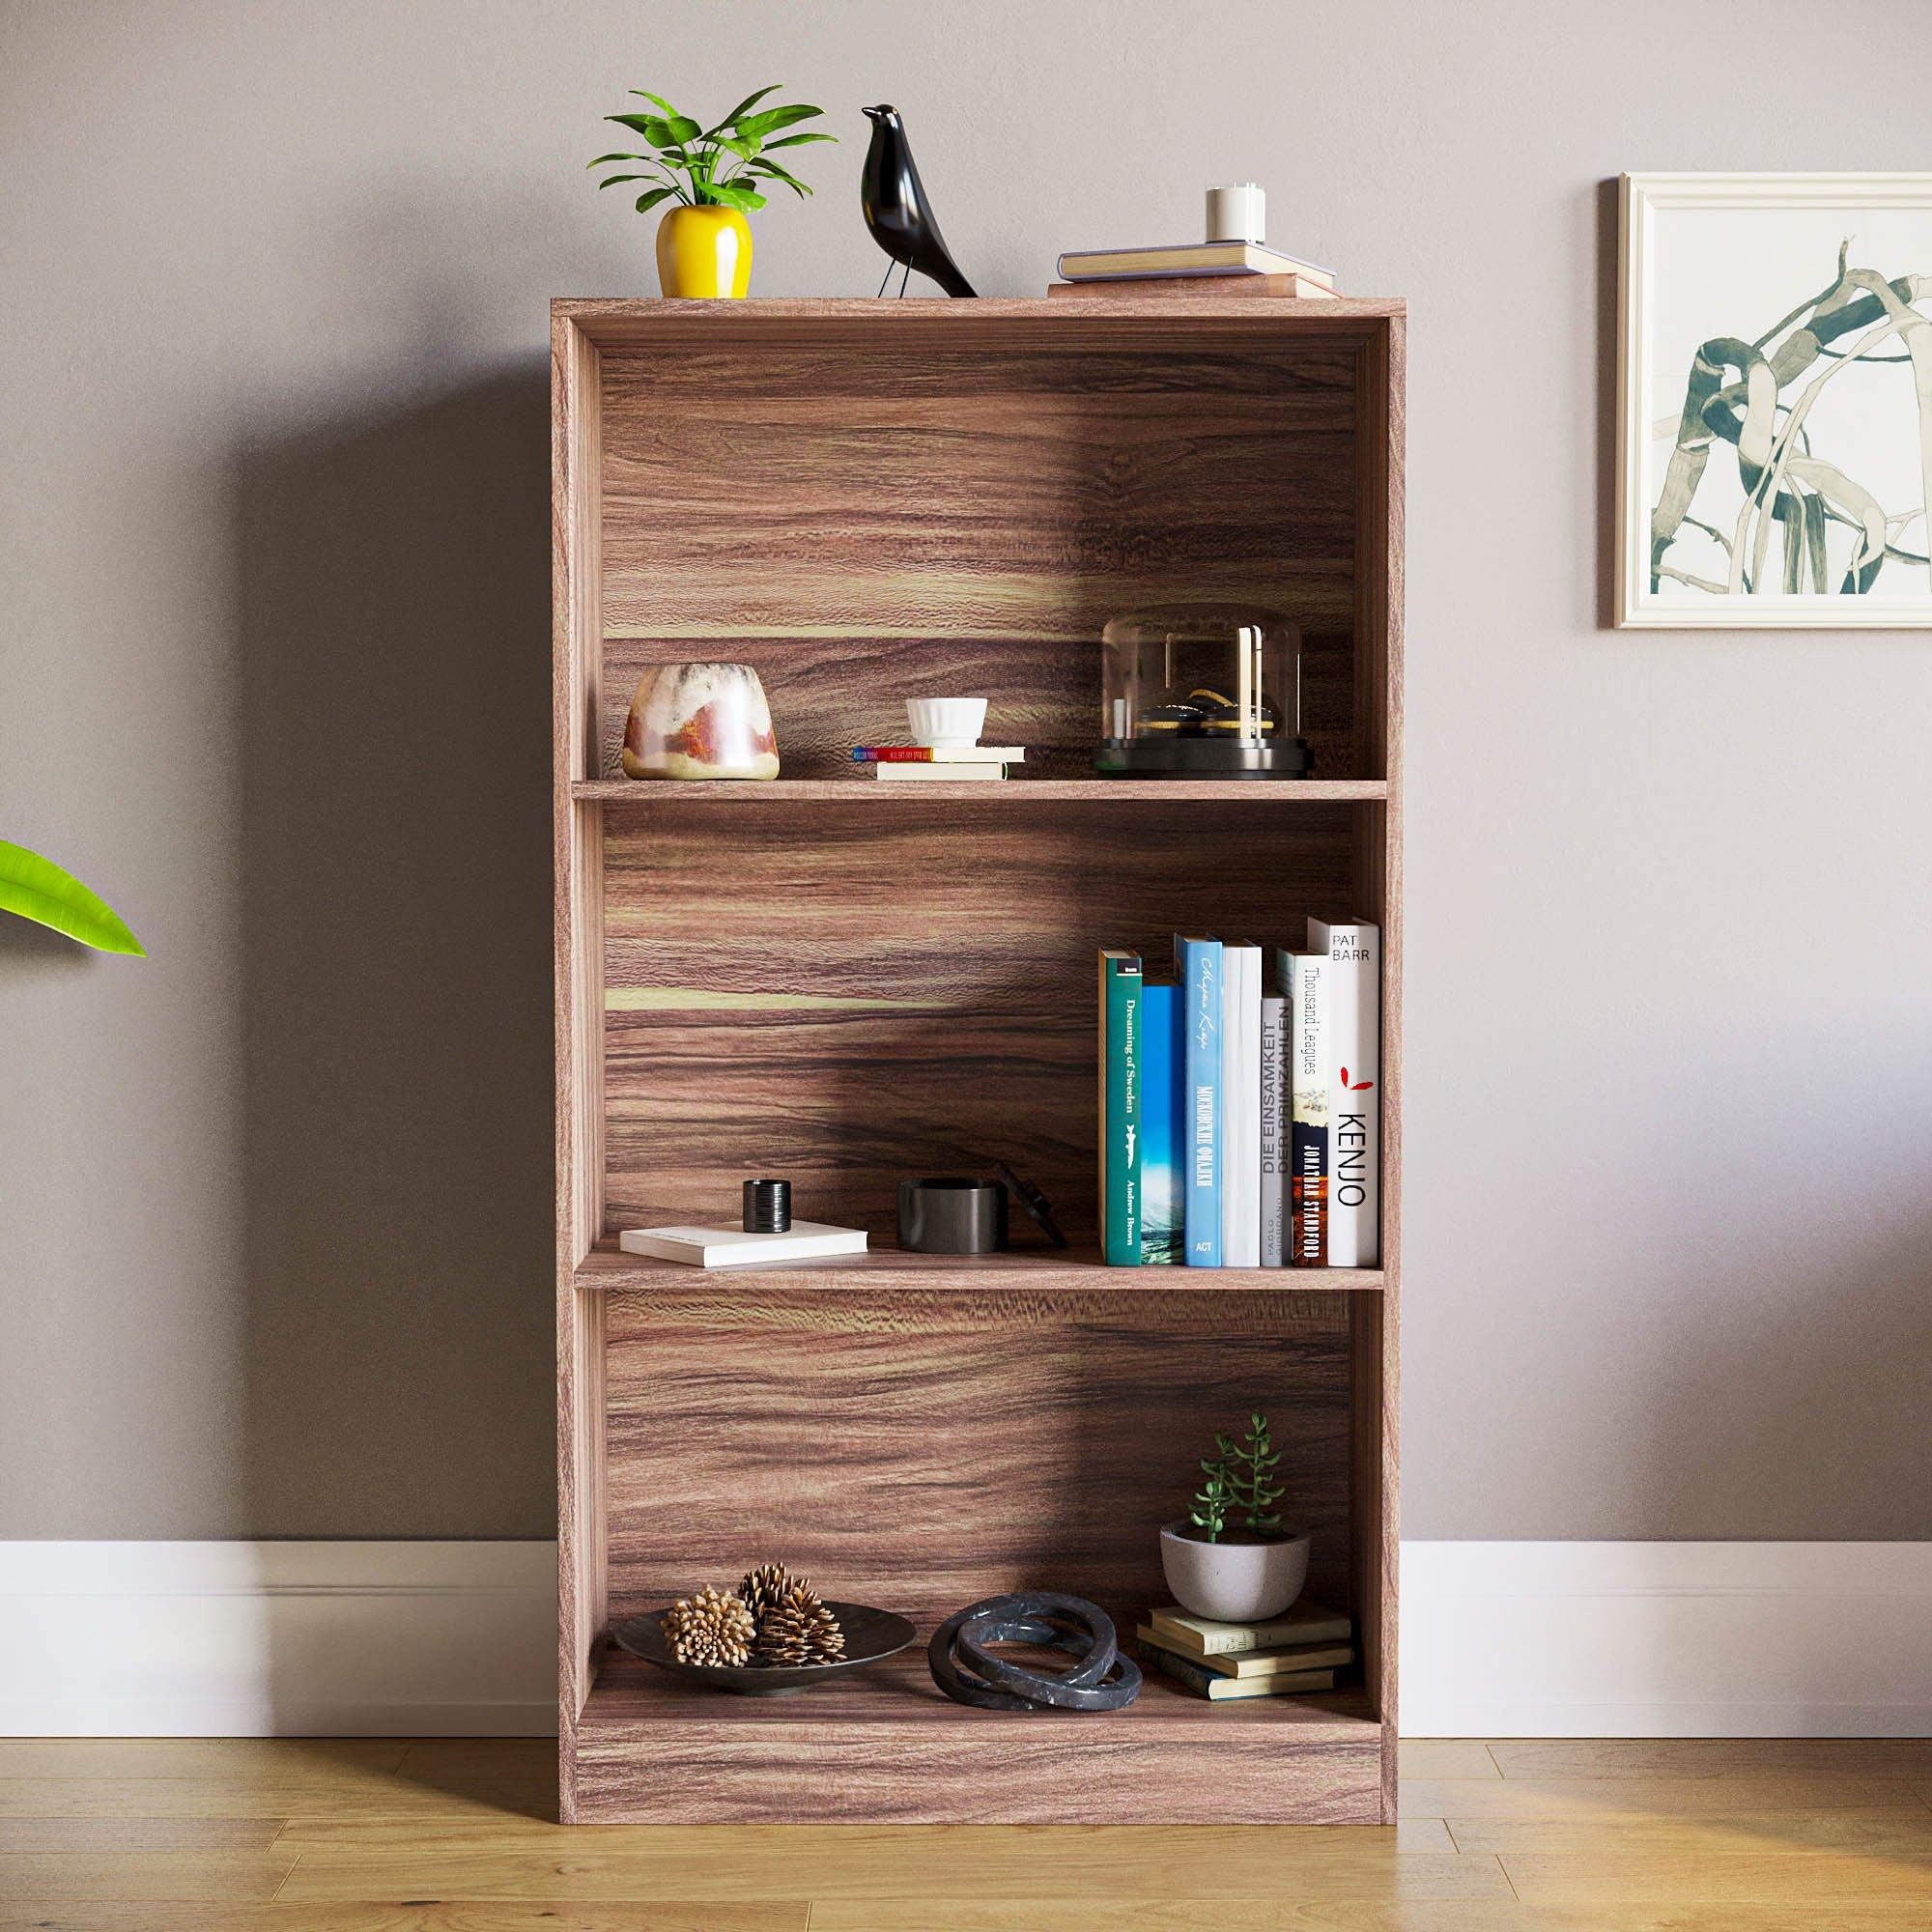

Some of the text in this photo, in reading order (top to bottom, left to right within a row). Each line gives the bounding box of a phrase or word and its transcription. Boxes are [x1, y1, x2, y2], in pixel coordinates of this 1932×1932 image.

[1332, 935, 1358, 946] PAT
[1332, 950, 1370, 961] BARR
[1124, 999, 1136, 1114] Dreaming of Sweden
[1301, 967, 1320, 1075] Thousand Leagues
[1263, 1022, 1275, 1175] DIE EINSAMKEIT
[1277, 1006, 1290, 1174] DER PRIMZAHLEN
[1126, 1180, 1135, 1246] Andrew Brown
[1303, 1145, 1320, 1259] JONATHAN STANDFORD
[1337, 1114, 1367, 1208] KENJO
